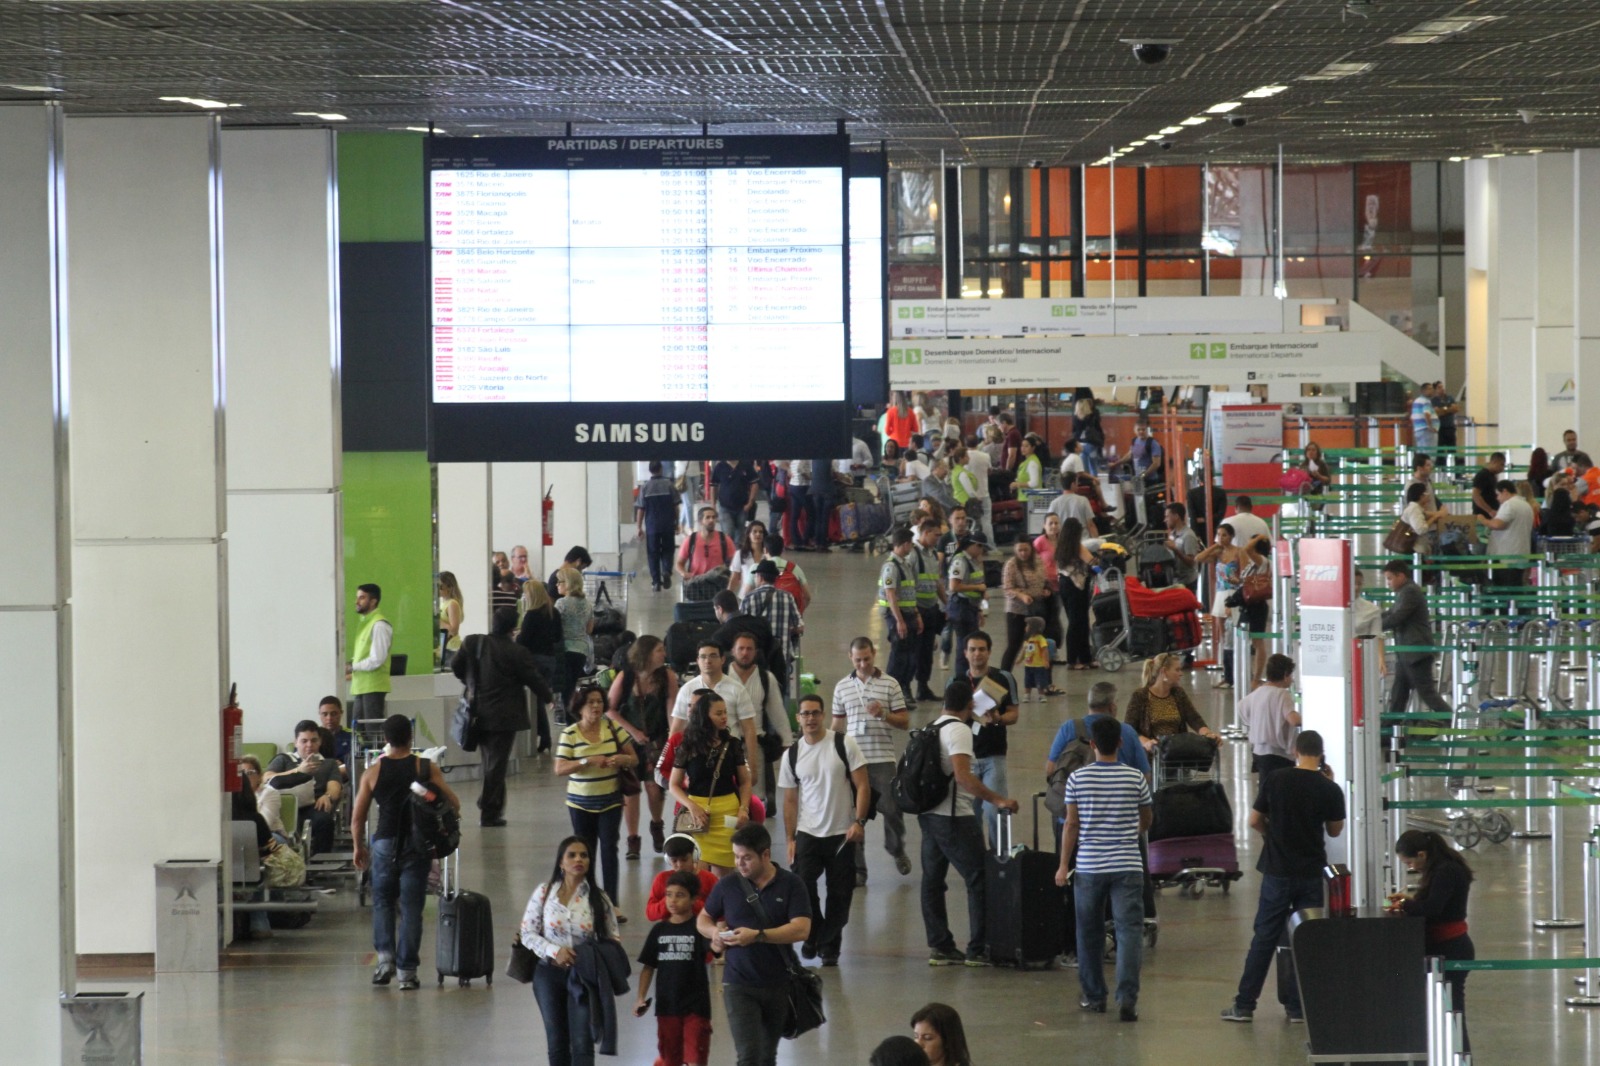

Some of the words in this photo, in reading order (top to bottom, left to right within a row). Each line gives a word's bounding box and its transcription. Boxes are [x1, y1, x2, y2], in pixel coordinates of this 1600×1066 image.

[548, 138, 618, 151] PARTIDAS
[629, 137, 725, 150] DEPARTURES
[924, 348, 974, 358] Desembarque
[1016, 346, 1062, 356] Internacional
[1230, 342, 1268, 352] Embarque
[1270, 342, 1319, 350] Internacional
[575, 422, 705, 443] SAMSUNG
[1304, 564, 1340, 582] TAM
[1308, 624, 1326, 632] LISTA
[1327, 624, 1336, 632] DE
[1310, 634, 1334, 642] ESPERA
